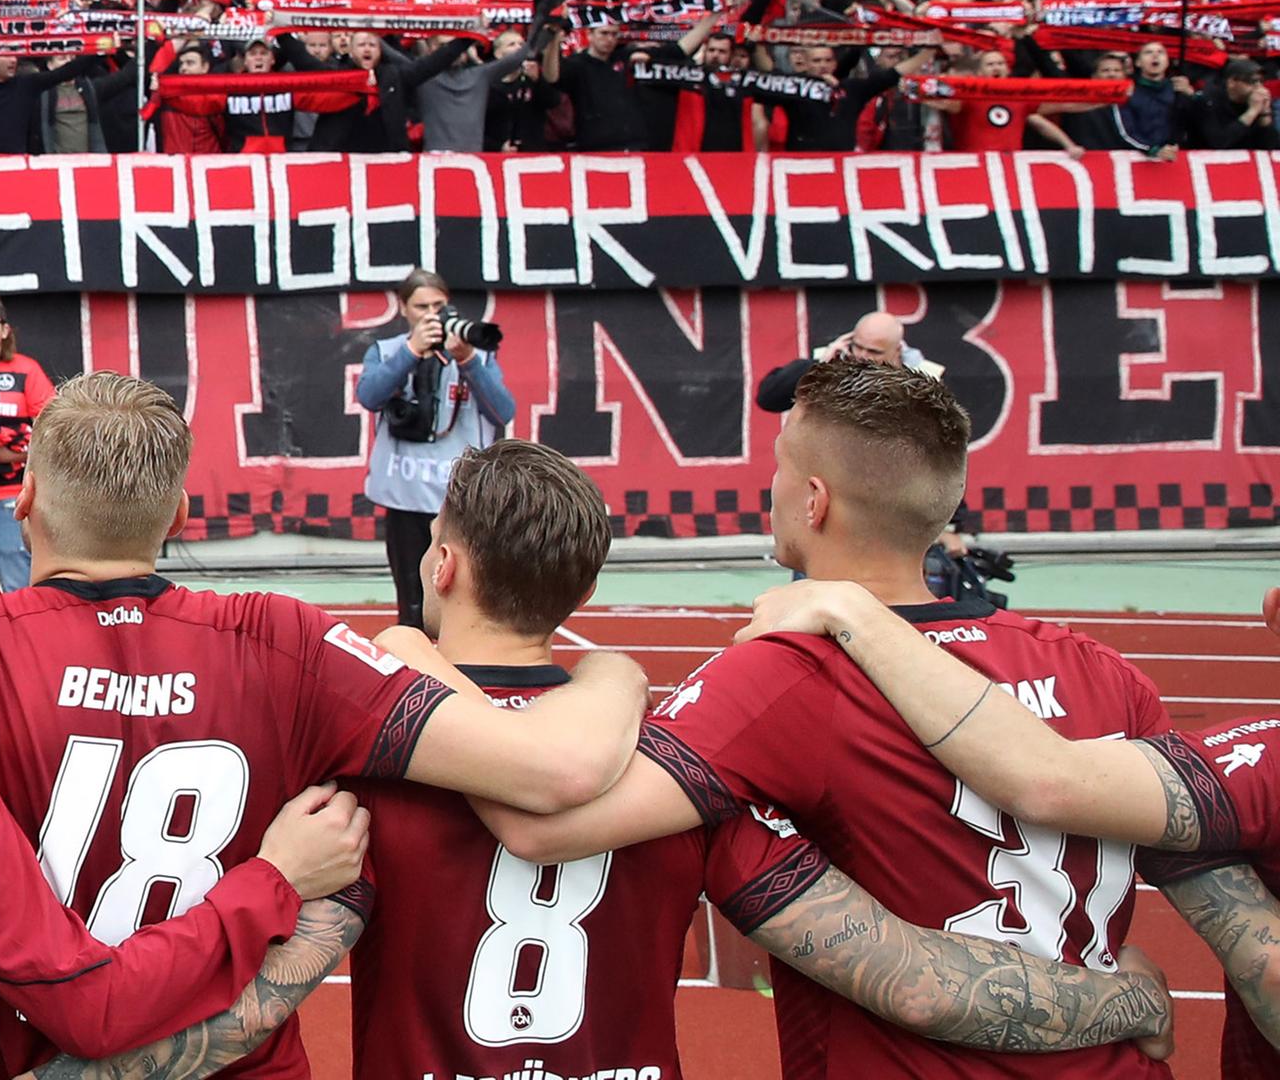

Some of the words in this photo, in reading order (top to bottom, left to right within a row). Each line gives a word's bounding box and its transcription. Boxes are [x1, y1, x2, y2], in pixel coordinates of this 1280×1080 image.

[114, 606, 144, 625] Club
[951, 626, 988, 644] Club
[37, 735, 250, 949] 18
[463, 844, 613, 1048] 8
